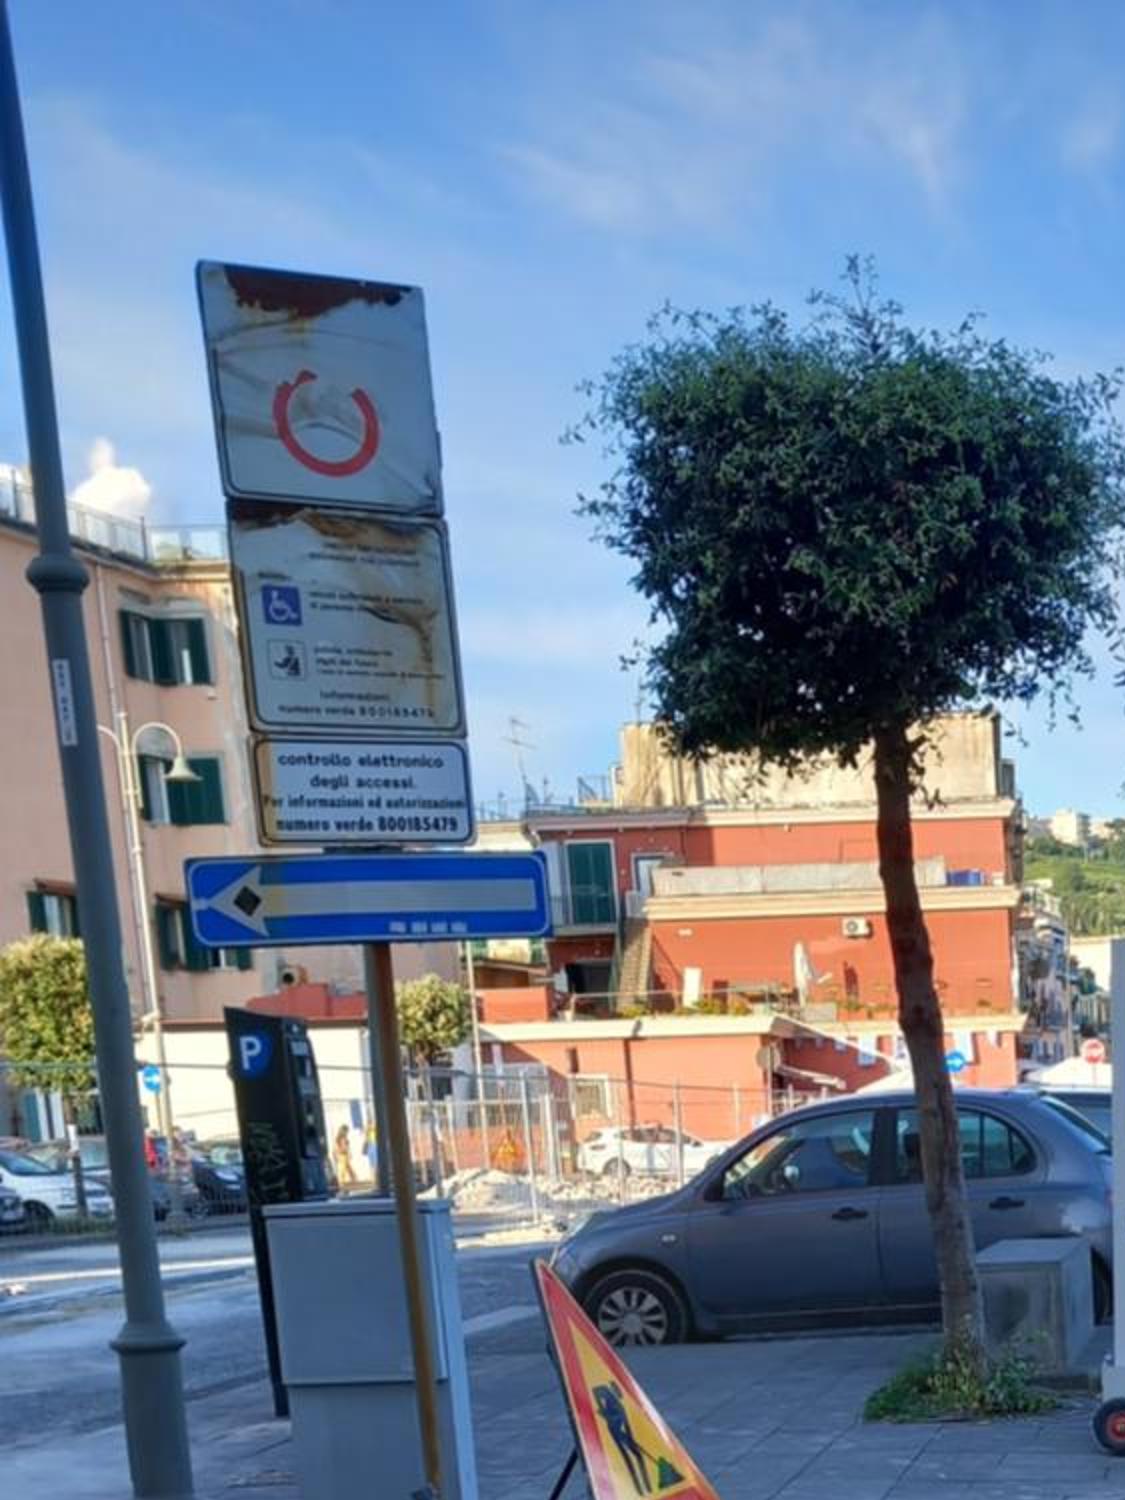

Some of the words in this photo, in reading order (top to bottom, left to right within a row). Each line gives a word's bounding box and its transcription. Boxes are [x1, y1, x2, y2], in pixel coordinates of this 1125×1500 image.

[278, 753, 351, 766] controllo
[358, 754, 444, 768] elettronico
[310, 775, 349, 790] degli
[287, 795, 364, 808] informazioni
[276, 819, 330, 831] numero
[334, 817, 373, 831] verde
[378, 816, 458, 832] 800185479
[240, 1036, 262, 1071] P
